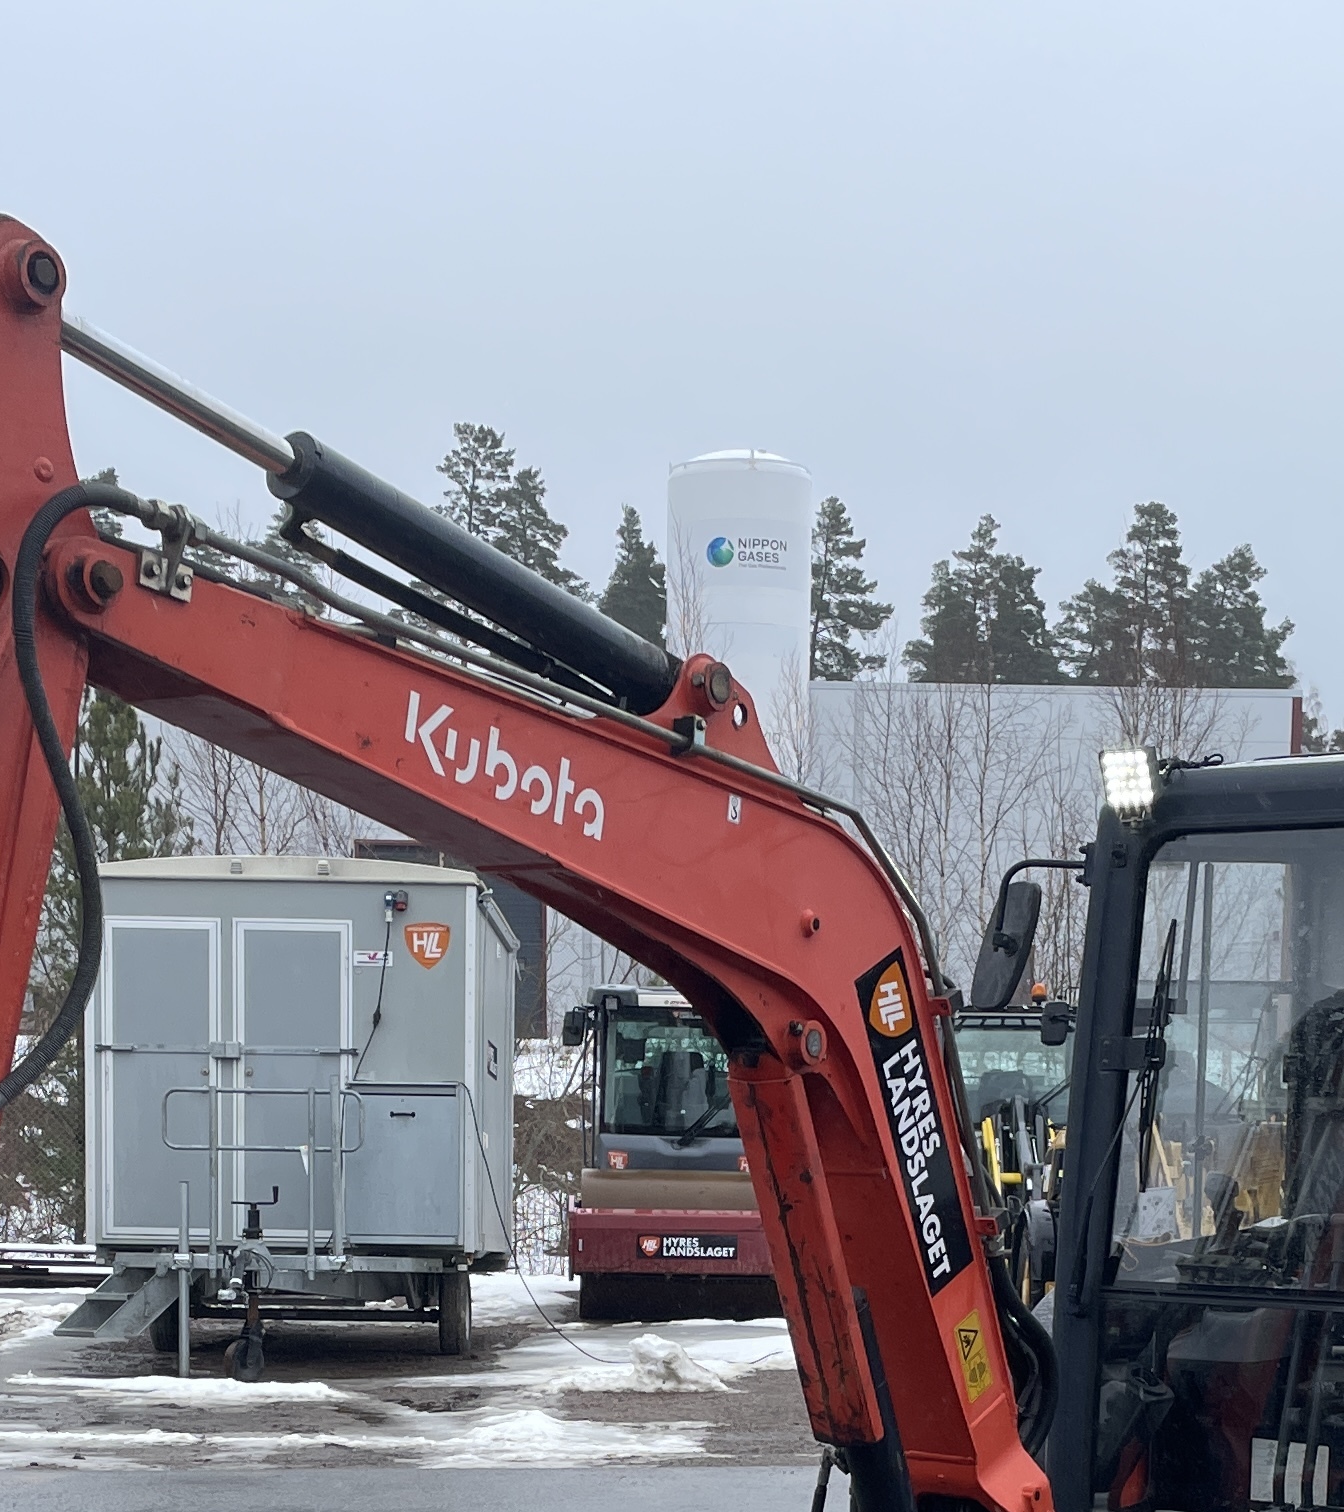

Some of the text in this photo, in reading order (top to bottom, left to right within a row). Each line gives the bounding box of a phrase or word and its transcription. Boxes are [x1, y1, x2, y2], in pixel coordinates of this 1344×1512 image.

[738, 537, 787, 552] NIPPON
[738, 551, 779, 563] GASES
[405, 689, 605, 841] Kubota
[899, 1038, 940, 1158] HYRES
[882, 1052, 951, 1279] LANDSLAGET
[662, 1237, 699, 1248] HYRES
[662, 1246, 735, 1258] LANDSLAGET
